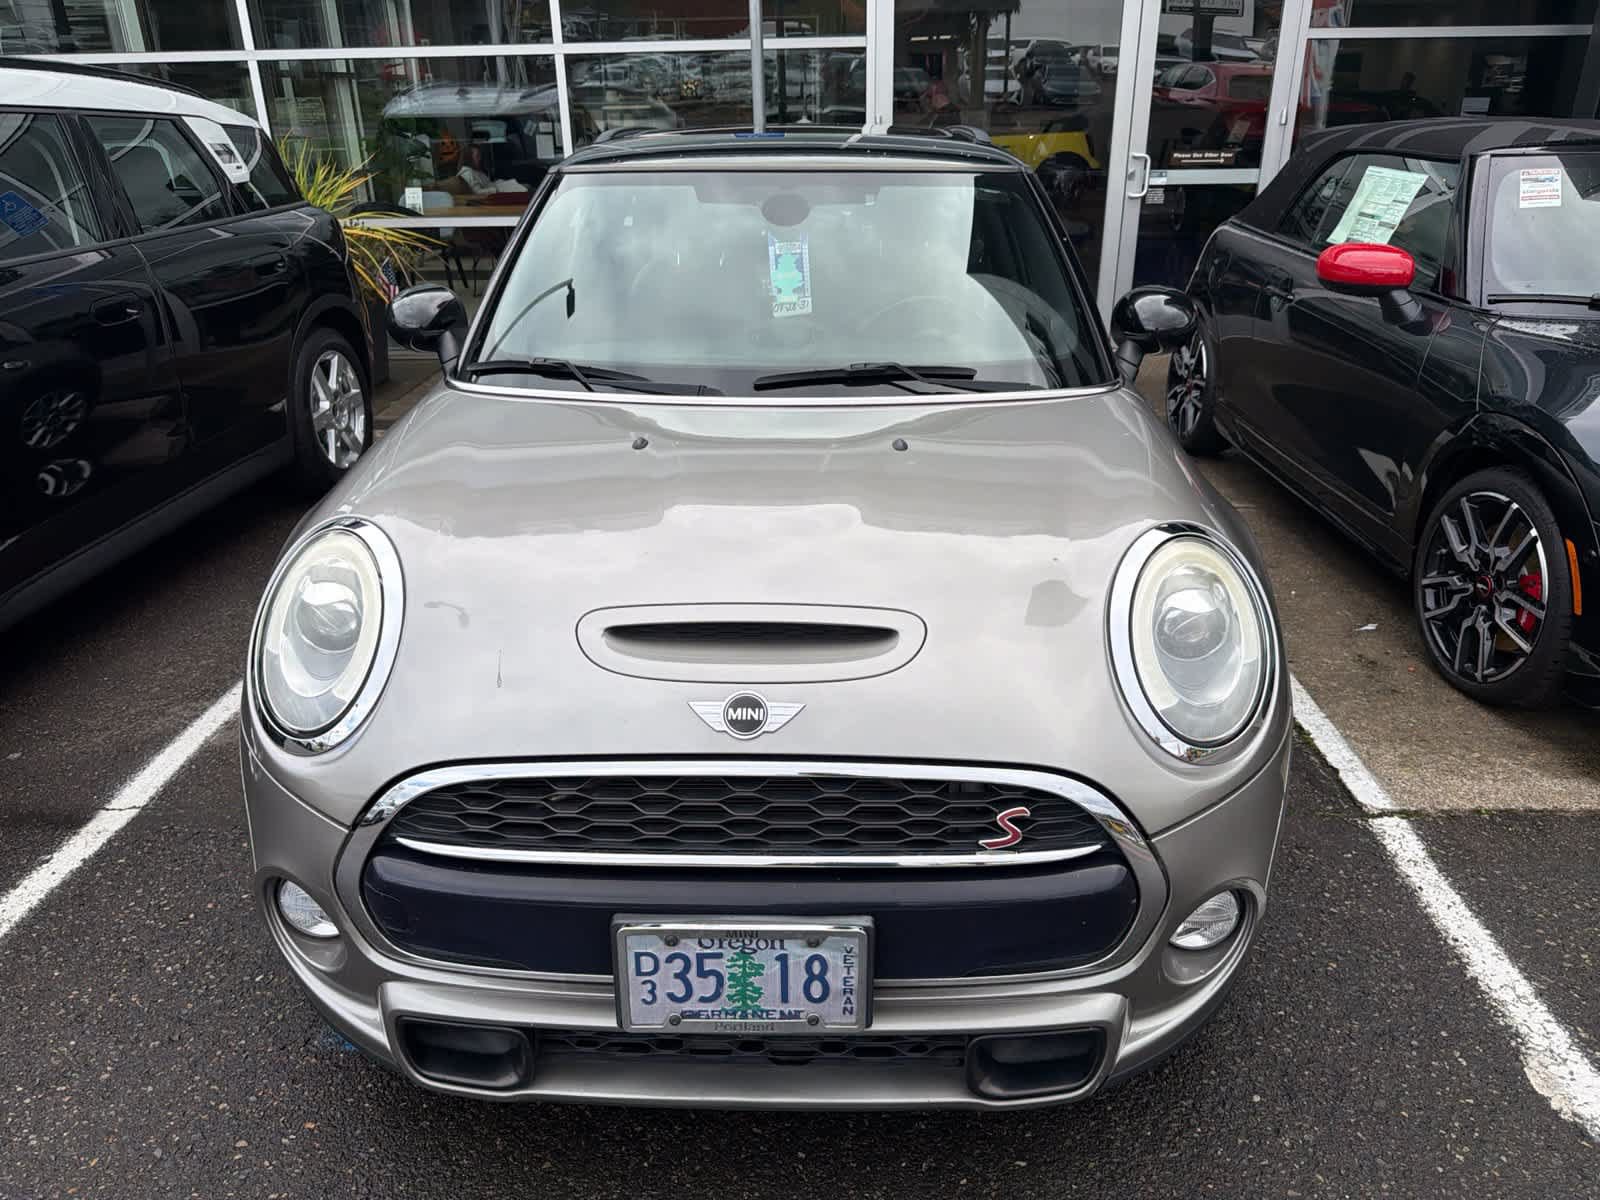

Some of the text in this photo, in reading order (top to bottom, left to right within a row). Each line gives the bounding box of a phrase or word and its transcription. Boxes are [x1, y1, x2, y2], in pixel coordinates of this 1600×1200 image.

[728, 707, 764, 720] MINI
[978, 806, 1031, 850] S
[725, 930, 758, 938] MINI
[698, 936, 787, 955] Oregon
[843, 946, 854, 1016] VETERAN
